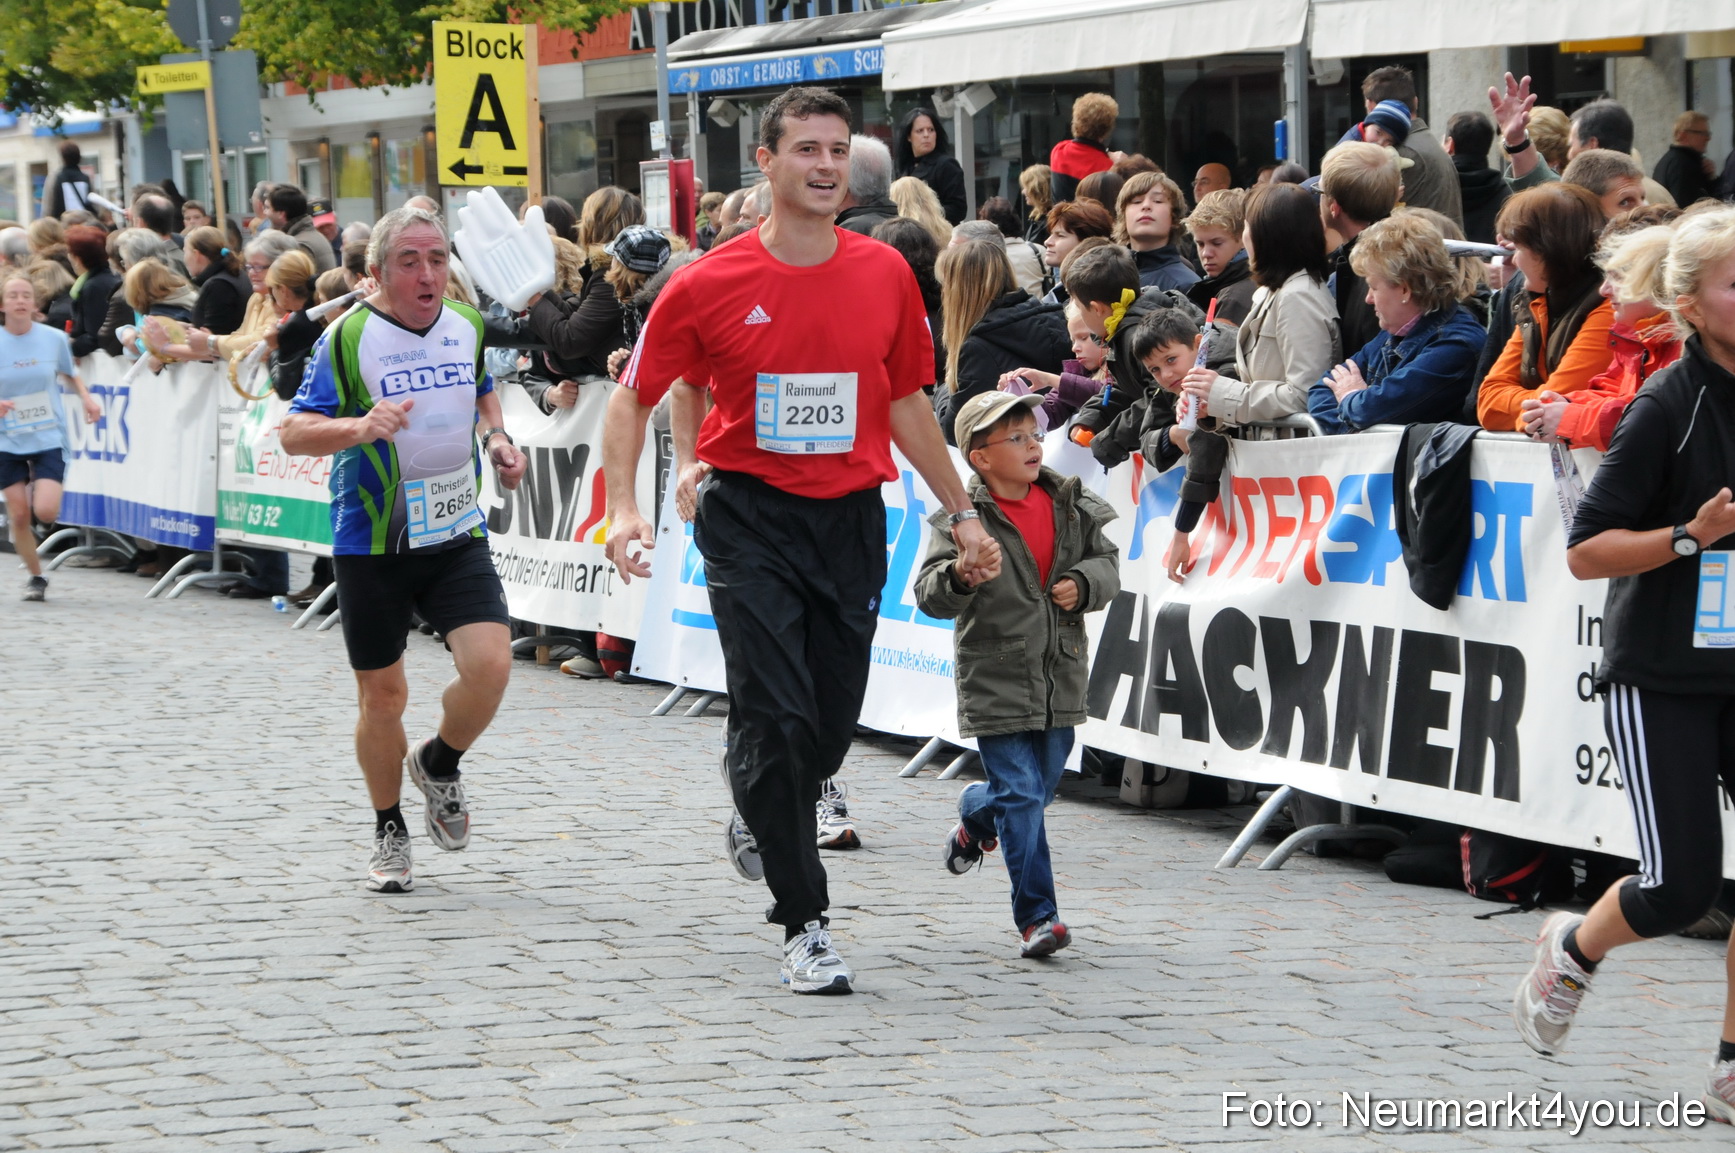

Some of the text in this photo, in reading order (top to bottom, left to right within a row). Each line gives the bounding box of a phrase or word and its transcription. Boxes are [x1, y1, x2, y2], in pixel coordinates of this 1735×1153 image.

[446, 29, 524, 60] Block
[153, 72, 198, 84] Toiletten
[710, 66, 740, 86] OBST
[753, 59, 800, 83] GEMÜSE
[459, 73, 517, 151] A
[744, 316, 772, 325] adidas
[379, 349, 427, 366] TEAM
[380, 362, 476, 398] BOCK
[785, 382, 836, 397] Raimund
[17, 405, 47, 420] 3725
[762, 402, 769, 414] C
[785, 404, 844, 425] 2203
[430, 474, 469, 496] Christian
[413, 505, 420, 515] B
[434, 488, 473, 520] 2685
[247, 503, 264, 526] 63
[263, 505, 283, 528] 52
[1087, 587, 1527, 804] HACKNER
